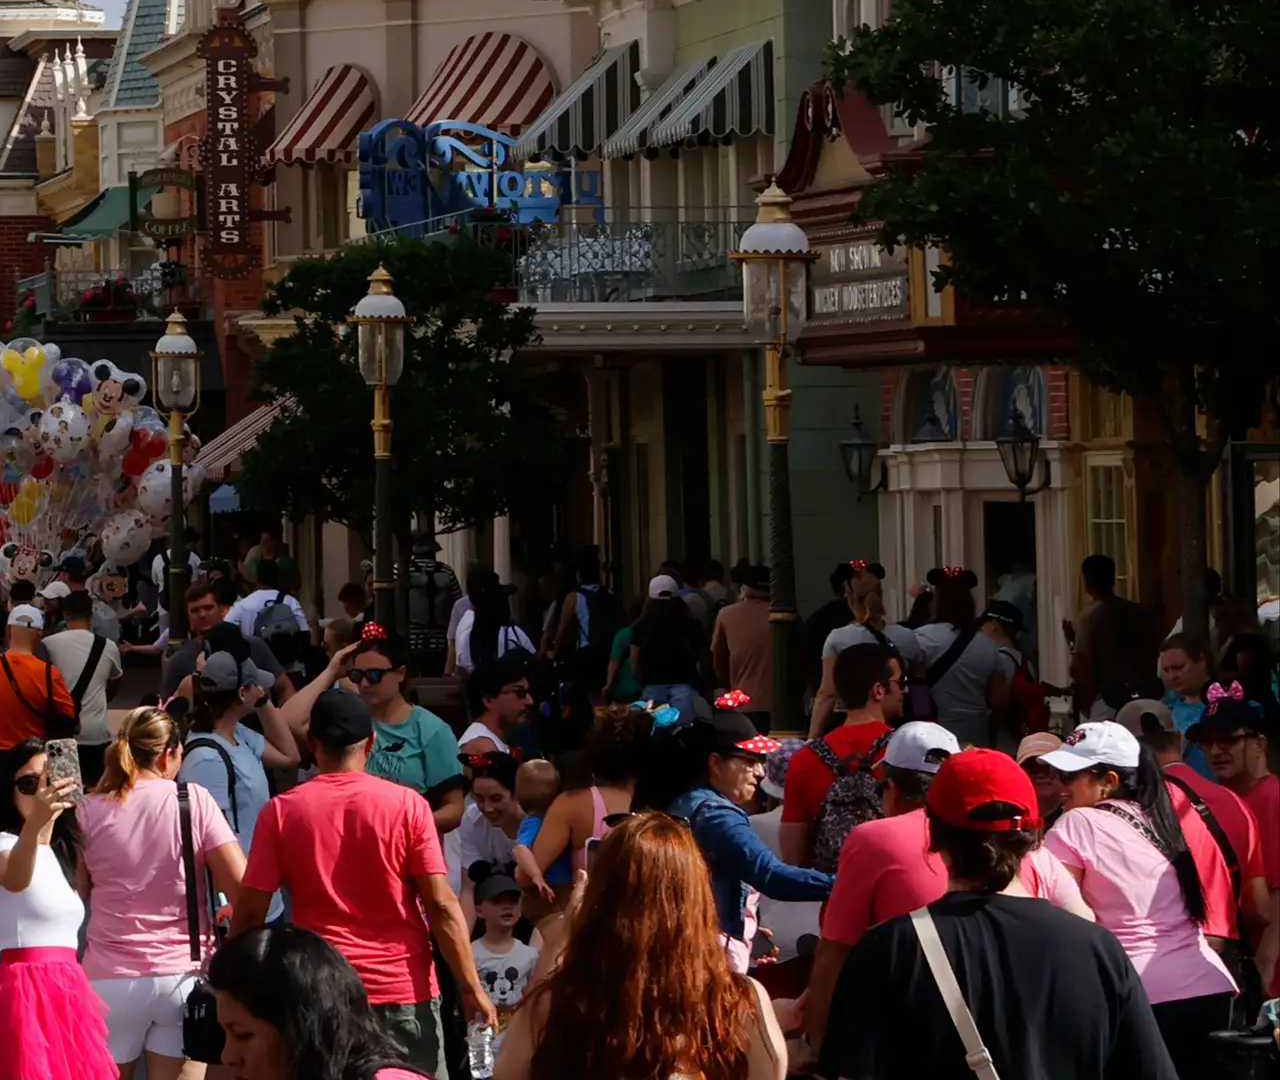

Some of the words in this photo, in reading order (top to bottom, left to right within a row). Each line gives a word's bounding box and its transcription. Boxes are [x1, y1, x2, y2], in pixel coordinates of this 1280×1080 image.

[216, 59, 240, 166] CRYSTAL
[144, 221, 189, 236] COFFEE
[217, 183, 241, 244] ARTS
